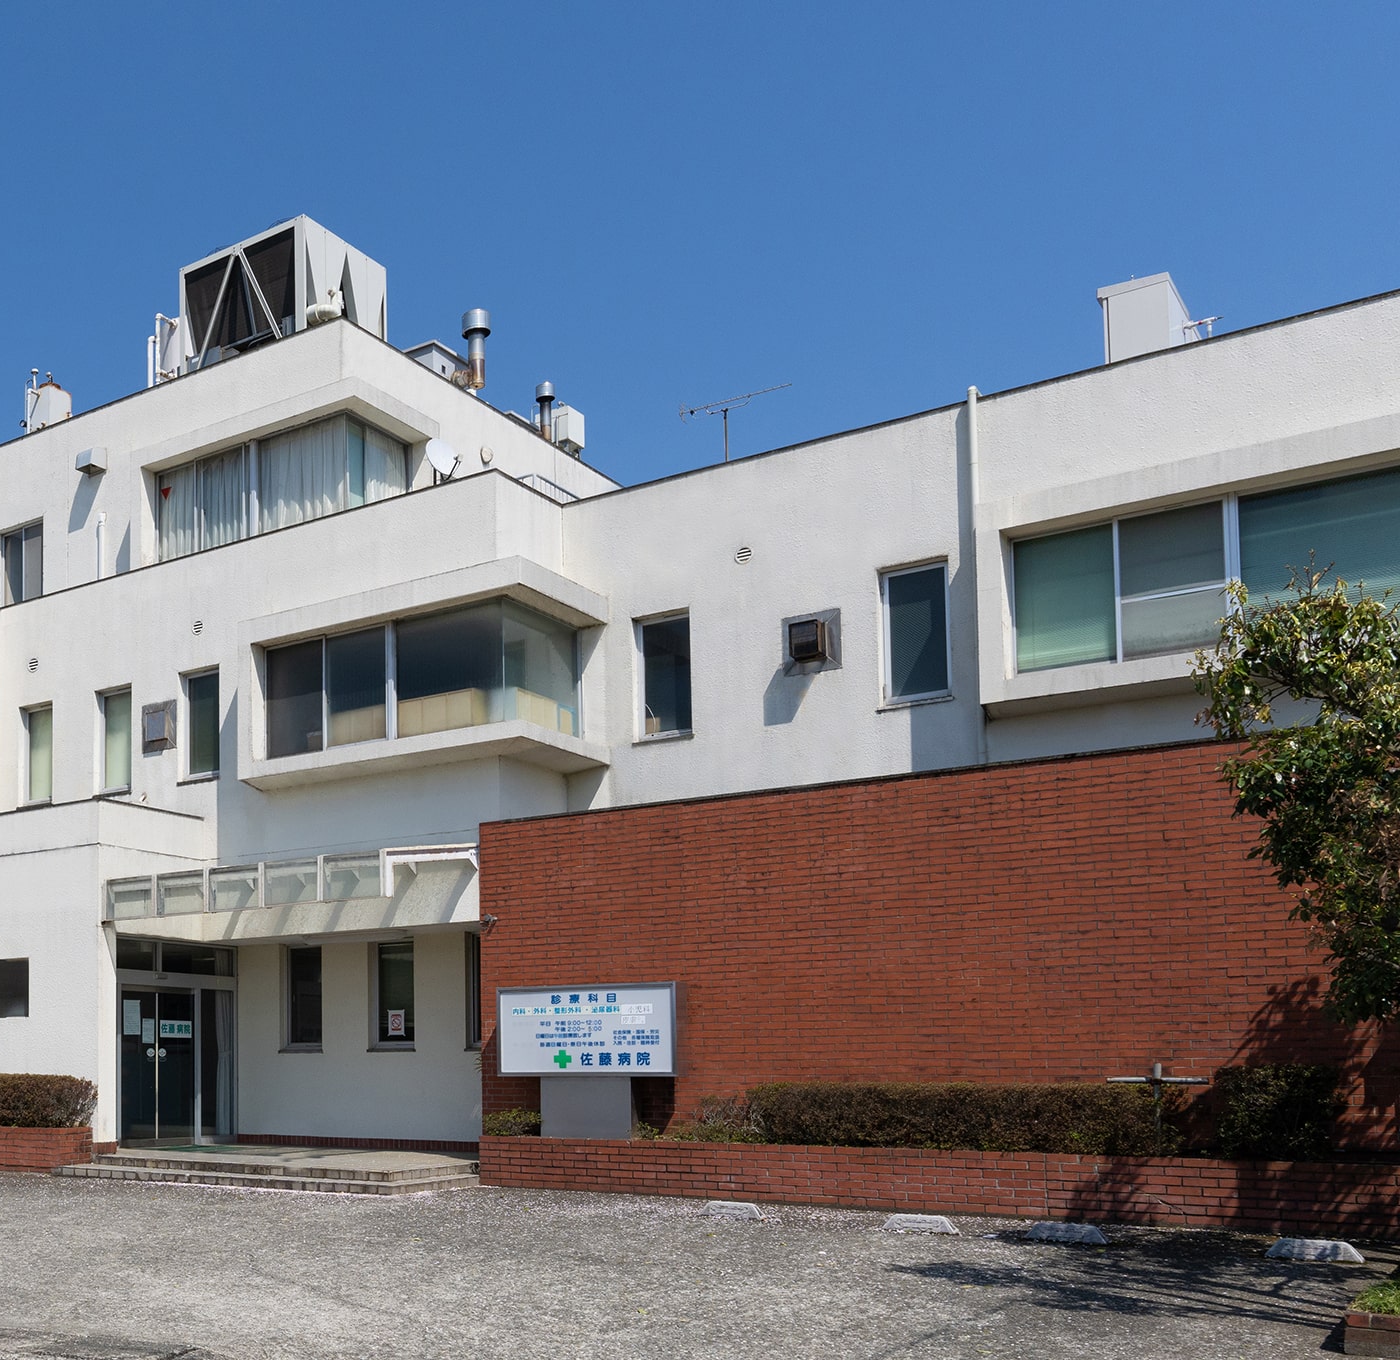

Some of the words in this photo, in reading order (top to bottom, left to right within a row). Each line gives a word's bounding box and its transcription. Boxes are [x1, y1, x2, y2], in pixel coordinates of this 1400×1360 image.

[551, 993, 617, 1004] 診療科目
[580, 1052, 651, 1066] 佐藤病院
